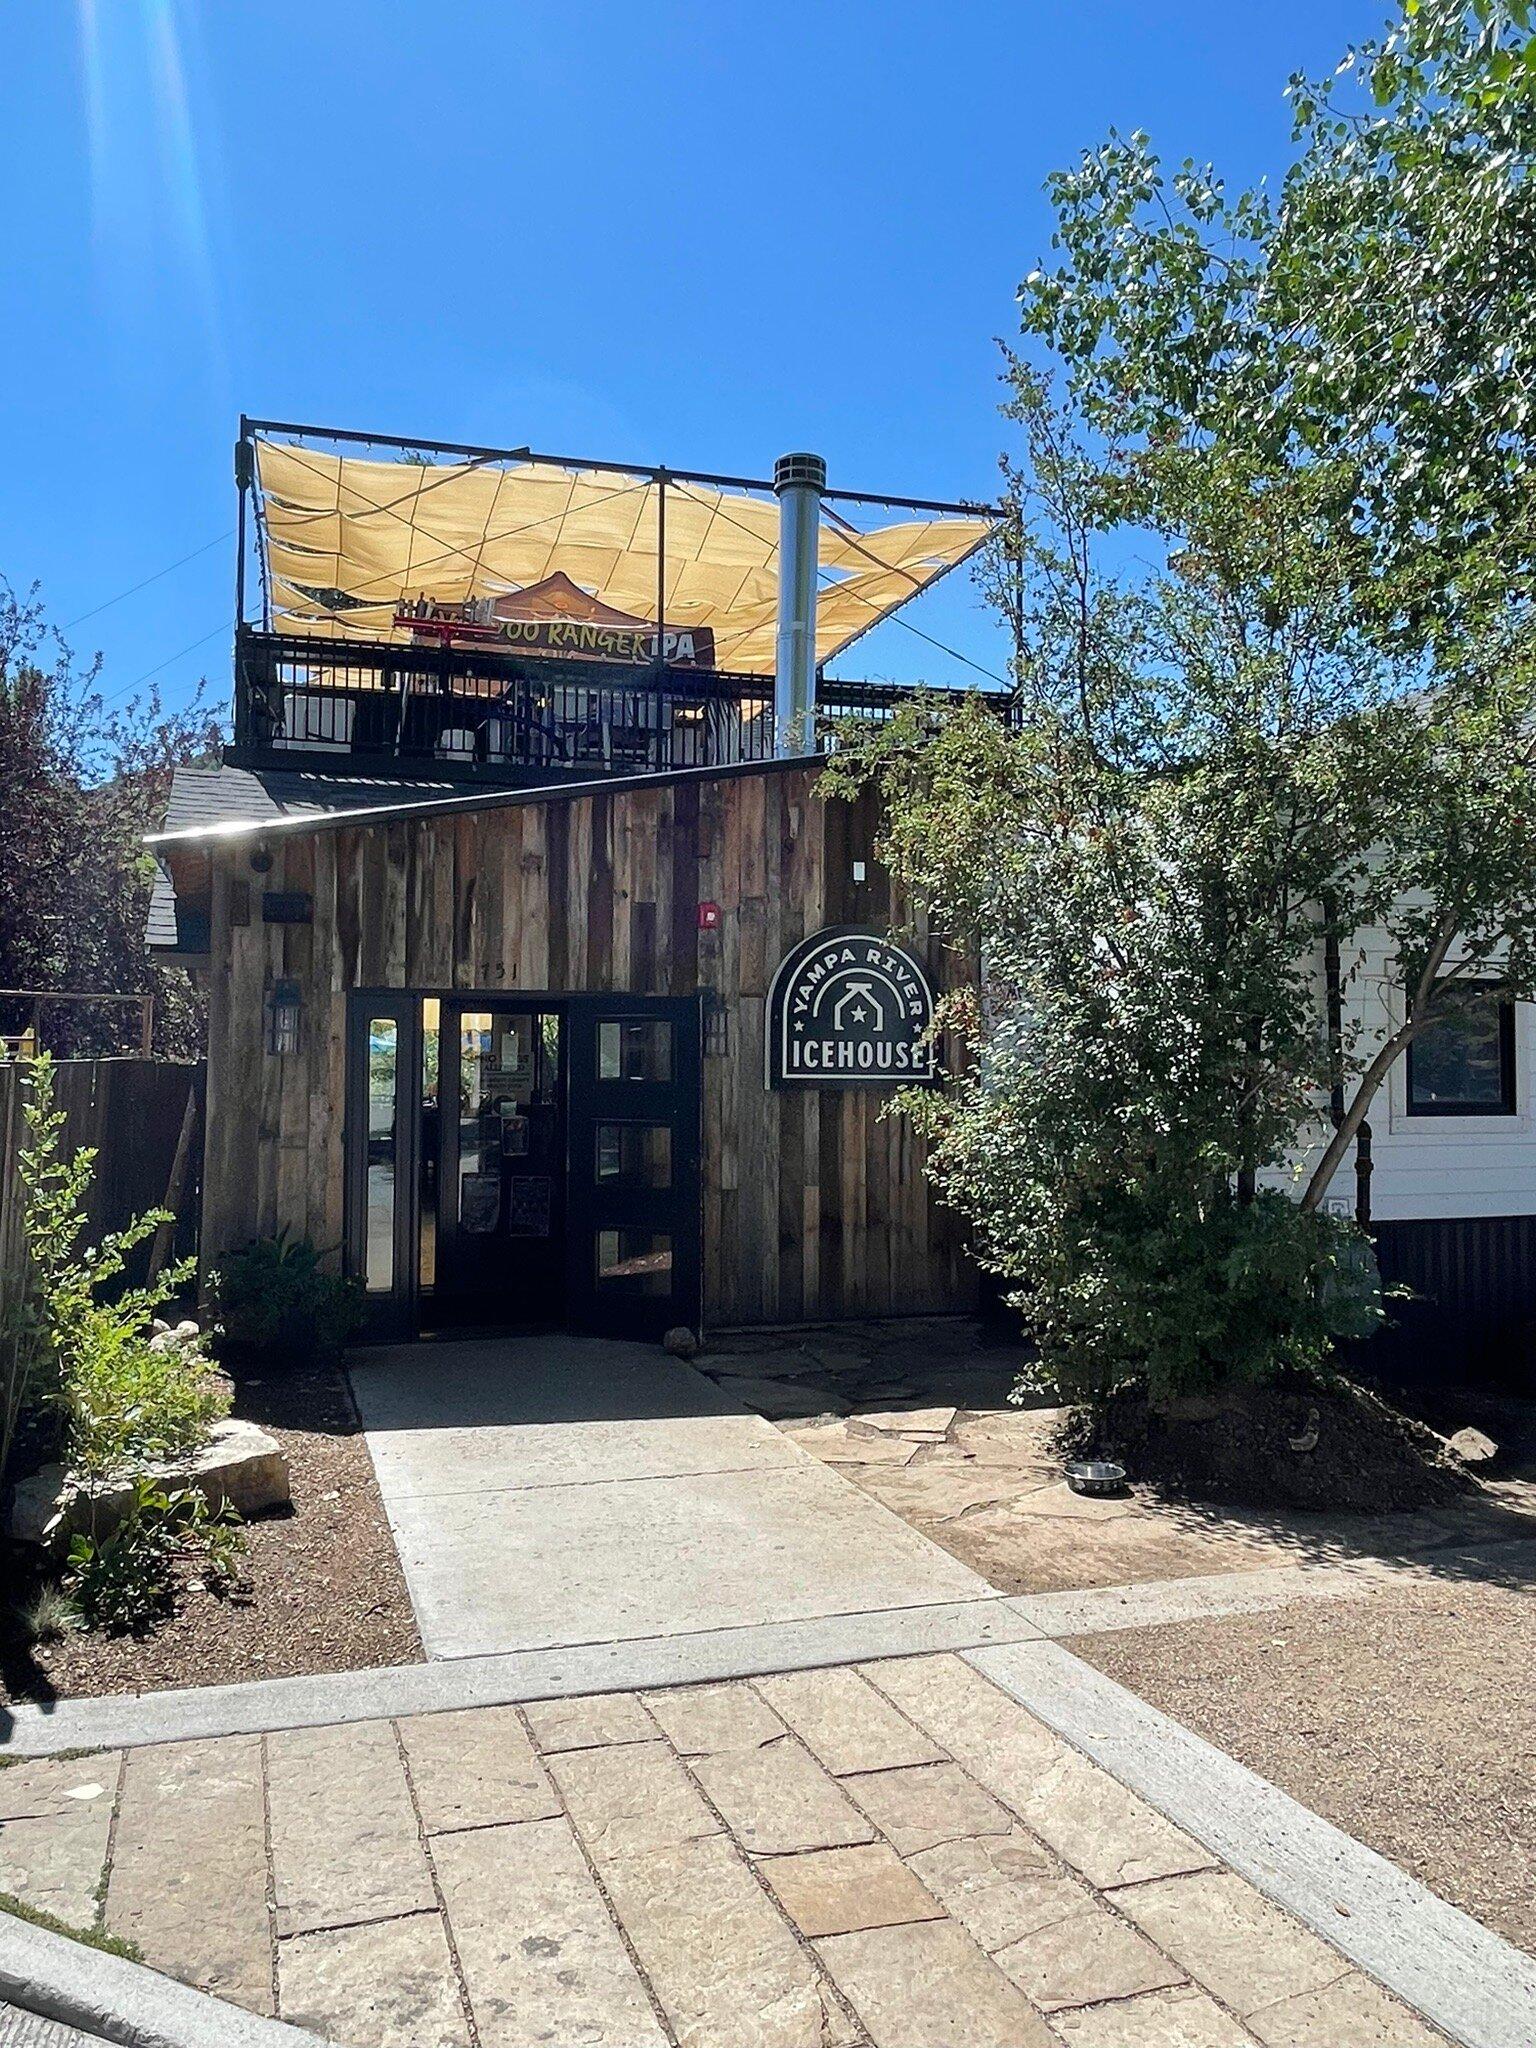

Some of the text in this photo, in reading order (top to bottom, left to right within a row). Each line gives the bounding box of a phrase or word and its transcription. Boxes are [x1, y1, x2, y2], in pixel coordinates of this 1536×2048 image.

[547, 623, 650, 658] RANGER
[651, 632, 696, 659] IPA
[793, 948, 923, 1016] YAMPA RIVER
[792, 1040, 924, 1069] ICEHOUSE
